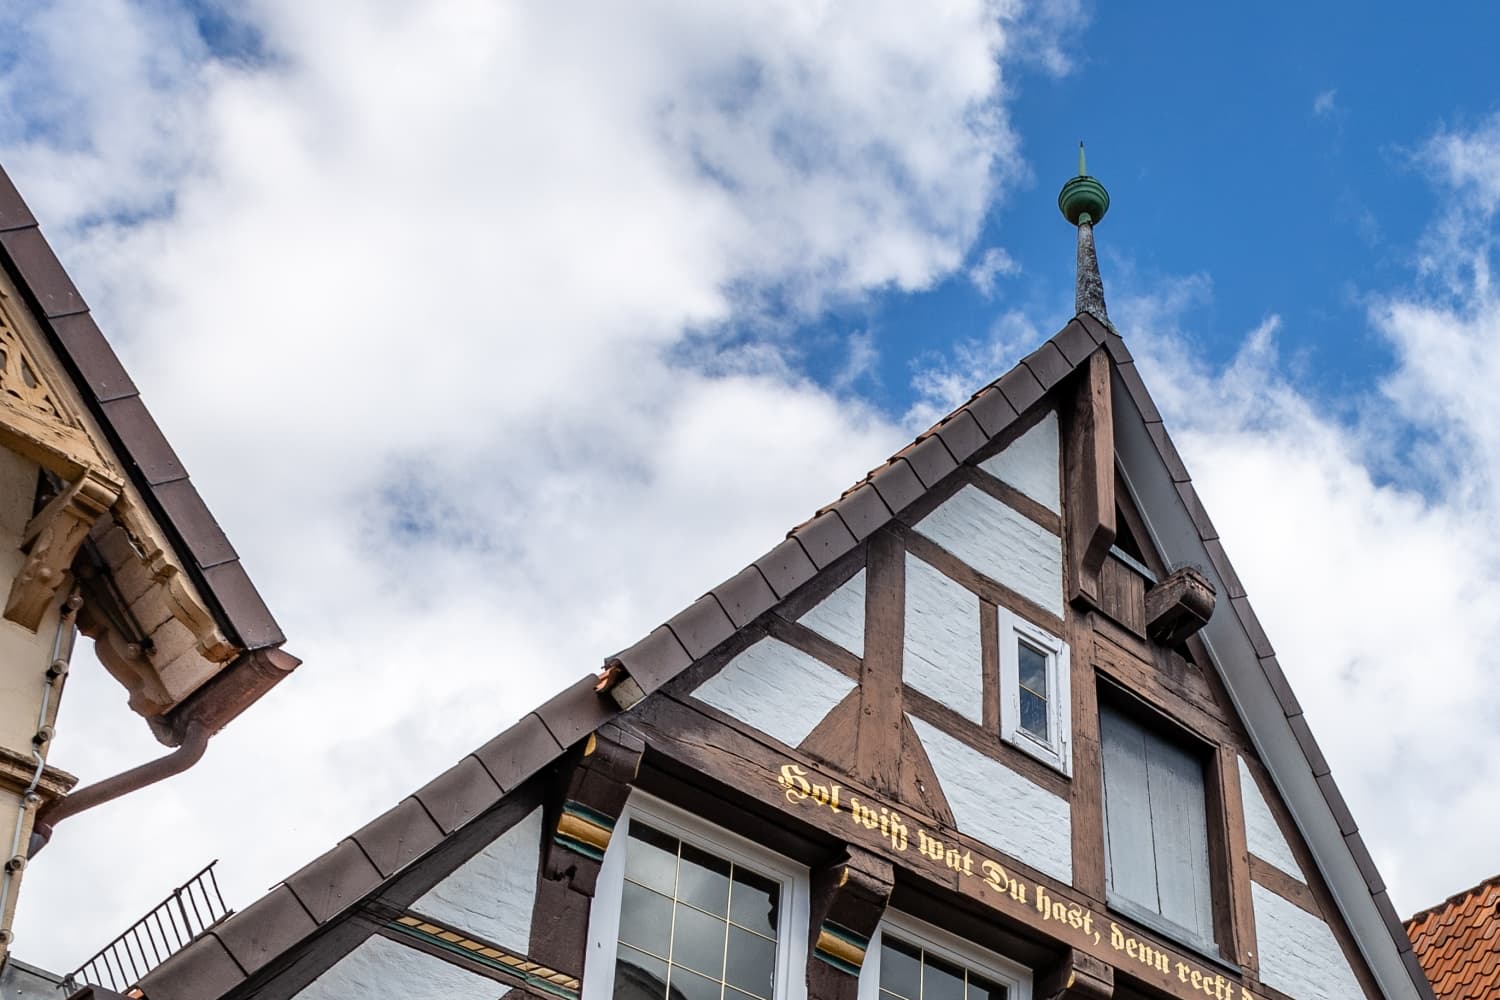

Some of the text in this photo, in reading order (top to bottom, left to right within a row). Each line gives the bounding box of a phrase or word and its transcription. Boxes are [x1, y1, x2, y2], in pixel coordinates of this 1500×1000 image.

[917, 829, 974, 876] wat
[982, 859, 1027, 903] Du
[1036, 885, 1100, 945] hast,
[1111, 922, 1170, 974] denn
